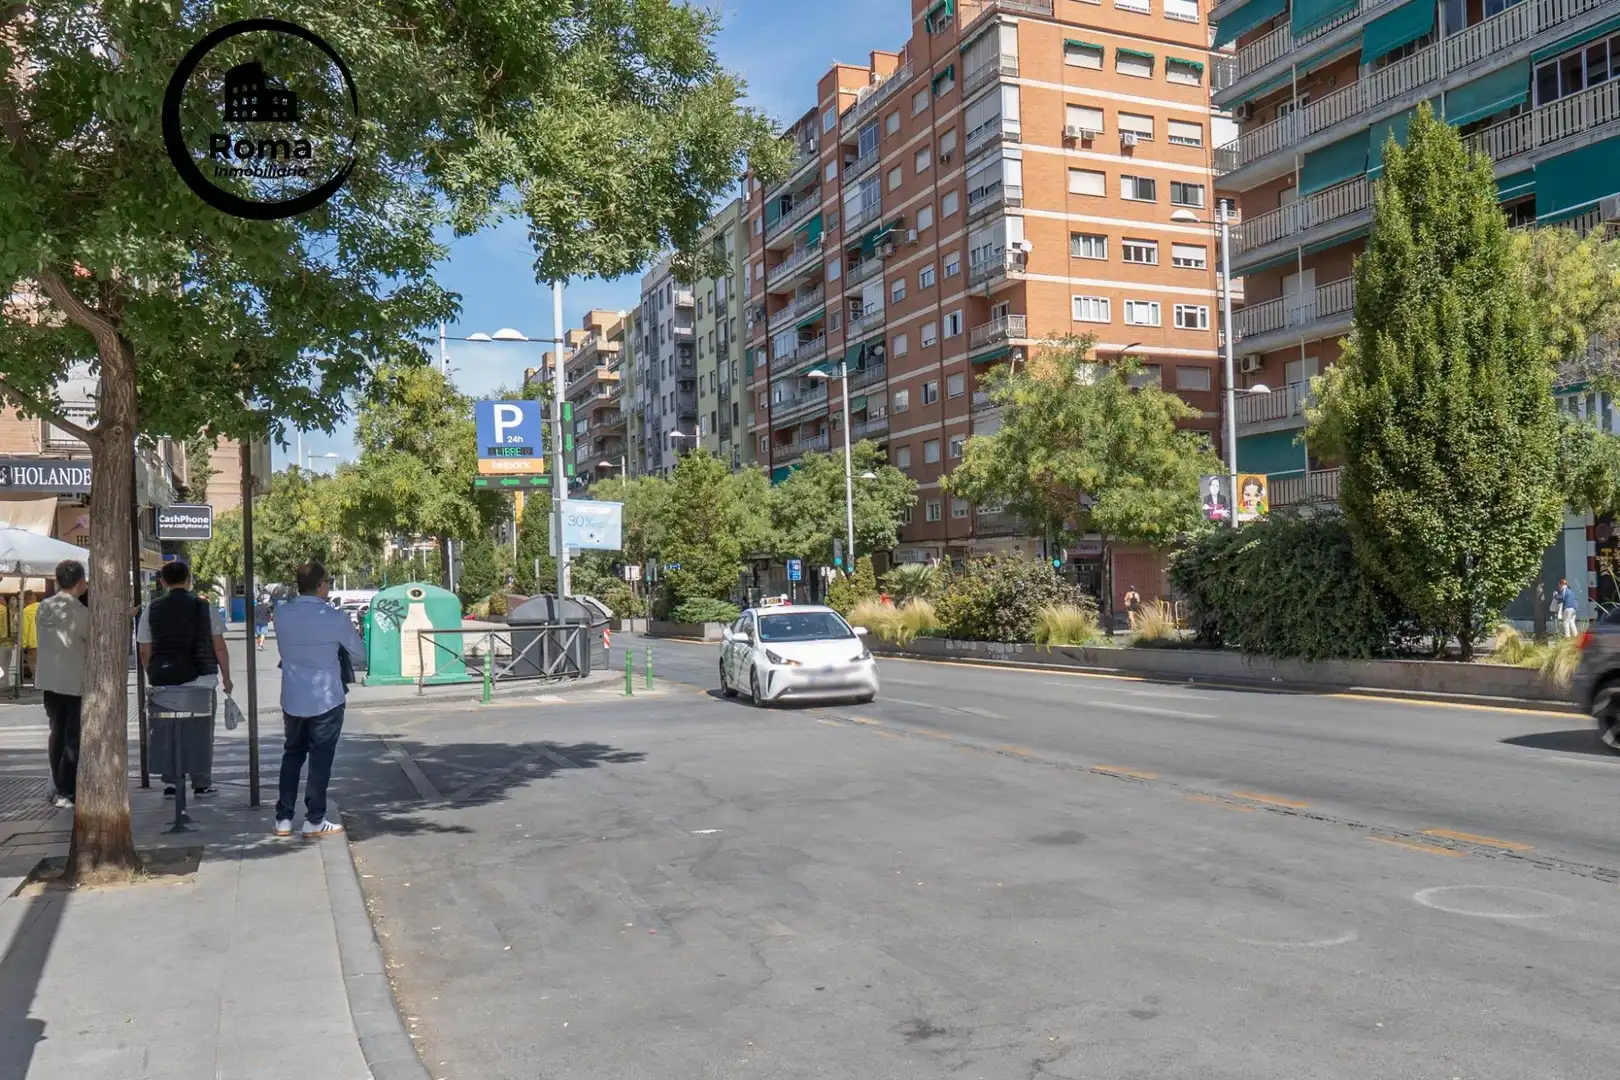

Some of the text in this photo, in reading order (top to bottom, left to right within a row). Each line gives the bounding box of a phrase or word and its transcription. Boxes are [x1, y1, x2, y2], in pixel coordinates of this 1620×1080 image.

[494, 404, 523, 443] P
[507, 435, 524, 443] 24h
[495, 447, 522, 457] LIBRE
[13, 467, 92, 486] HOLANDE
[158, 514, 209, 524] CashPhone
